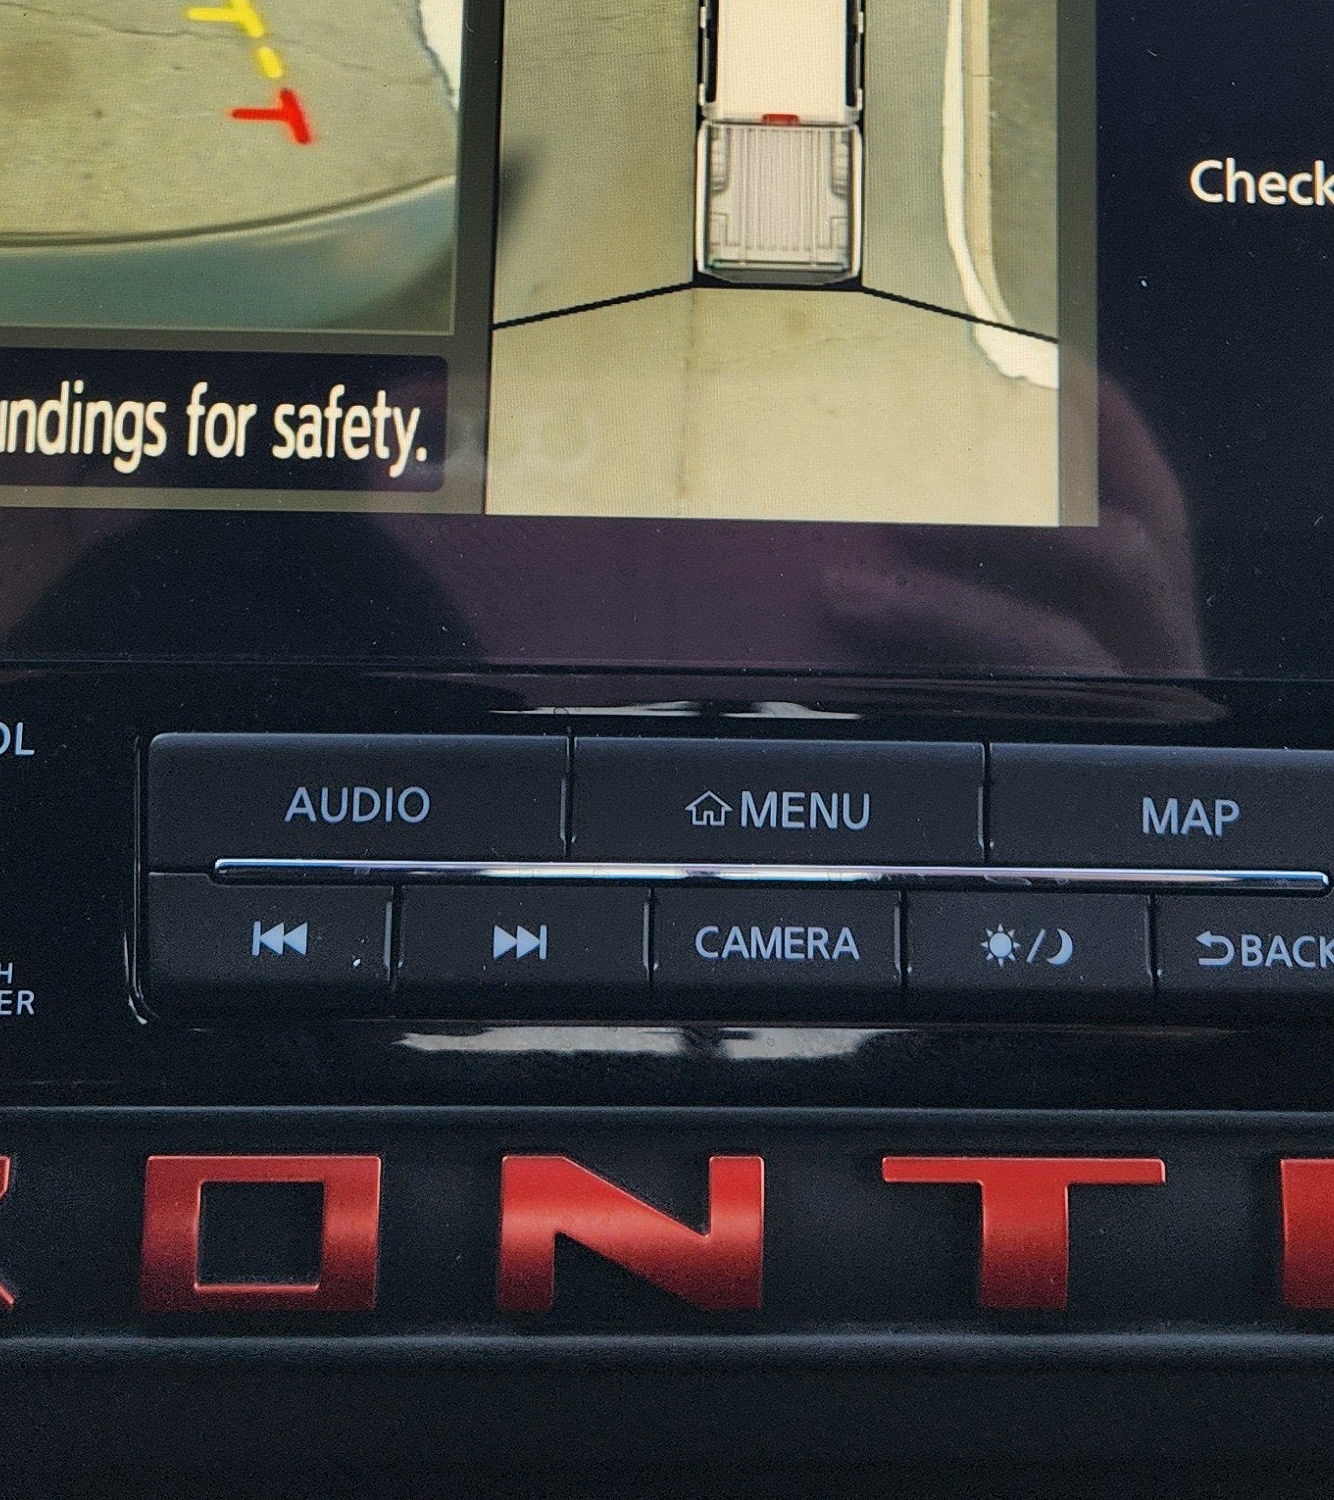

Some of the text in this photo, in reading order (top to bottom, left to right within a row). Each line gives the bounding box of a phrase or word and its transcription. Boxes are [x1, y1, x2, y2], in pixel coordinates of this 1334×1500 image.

[185, 381, 258, 459] for
[271, 384, 428, 479] safety.
[283, 785, 431, 824] AUDIO
[740, 789, 871, 831] MENU
[1141, 796, 1241, 838] MAP
[694, 924, 861, 961] CAMERA
